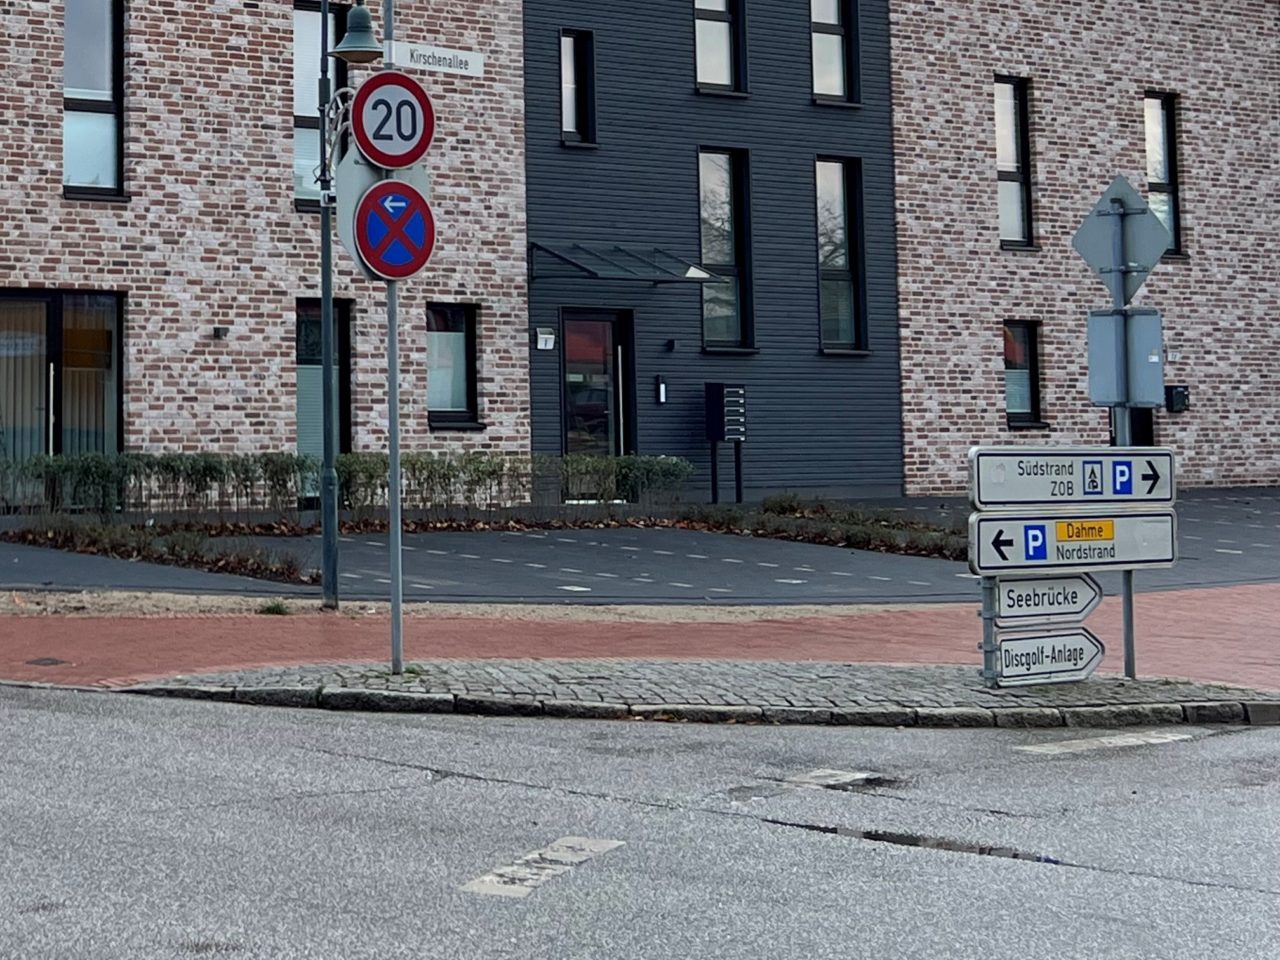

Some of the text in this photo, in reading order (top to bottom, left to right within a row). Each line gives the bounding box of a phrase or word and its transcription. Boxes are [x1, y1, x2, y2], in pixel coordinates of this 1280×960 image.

[409, 48, 470, 71] Kirschenallee
[371, 98, 418, 142] 20
[1017, 460, 1074, 476] Südstrand
[1116, 465, 1130, 491] P
[1050, 481, 1074, 497] ZOB
[1027, 529, 1043, 556] P
[1066, 523, 1104, 540] Dahme
[1056, 544, 1116, 560] Nordstrand
[1006, 587, 1078, 609] Seebrücke
[1004, 645, 1085, 672] Discgolf-Anlage
